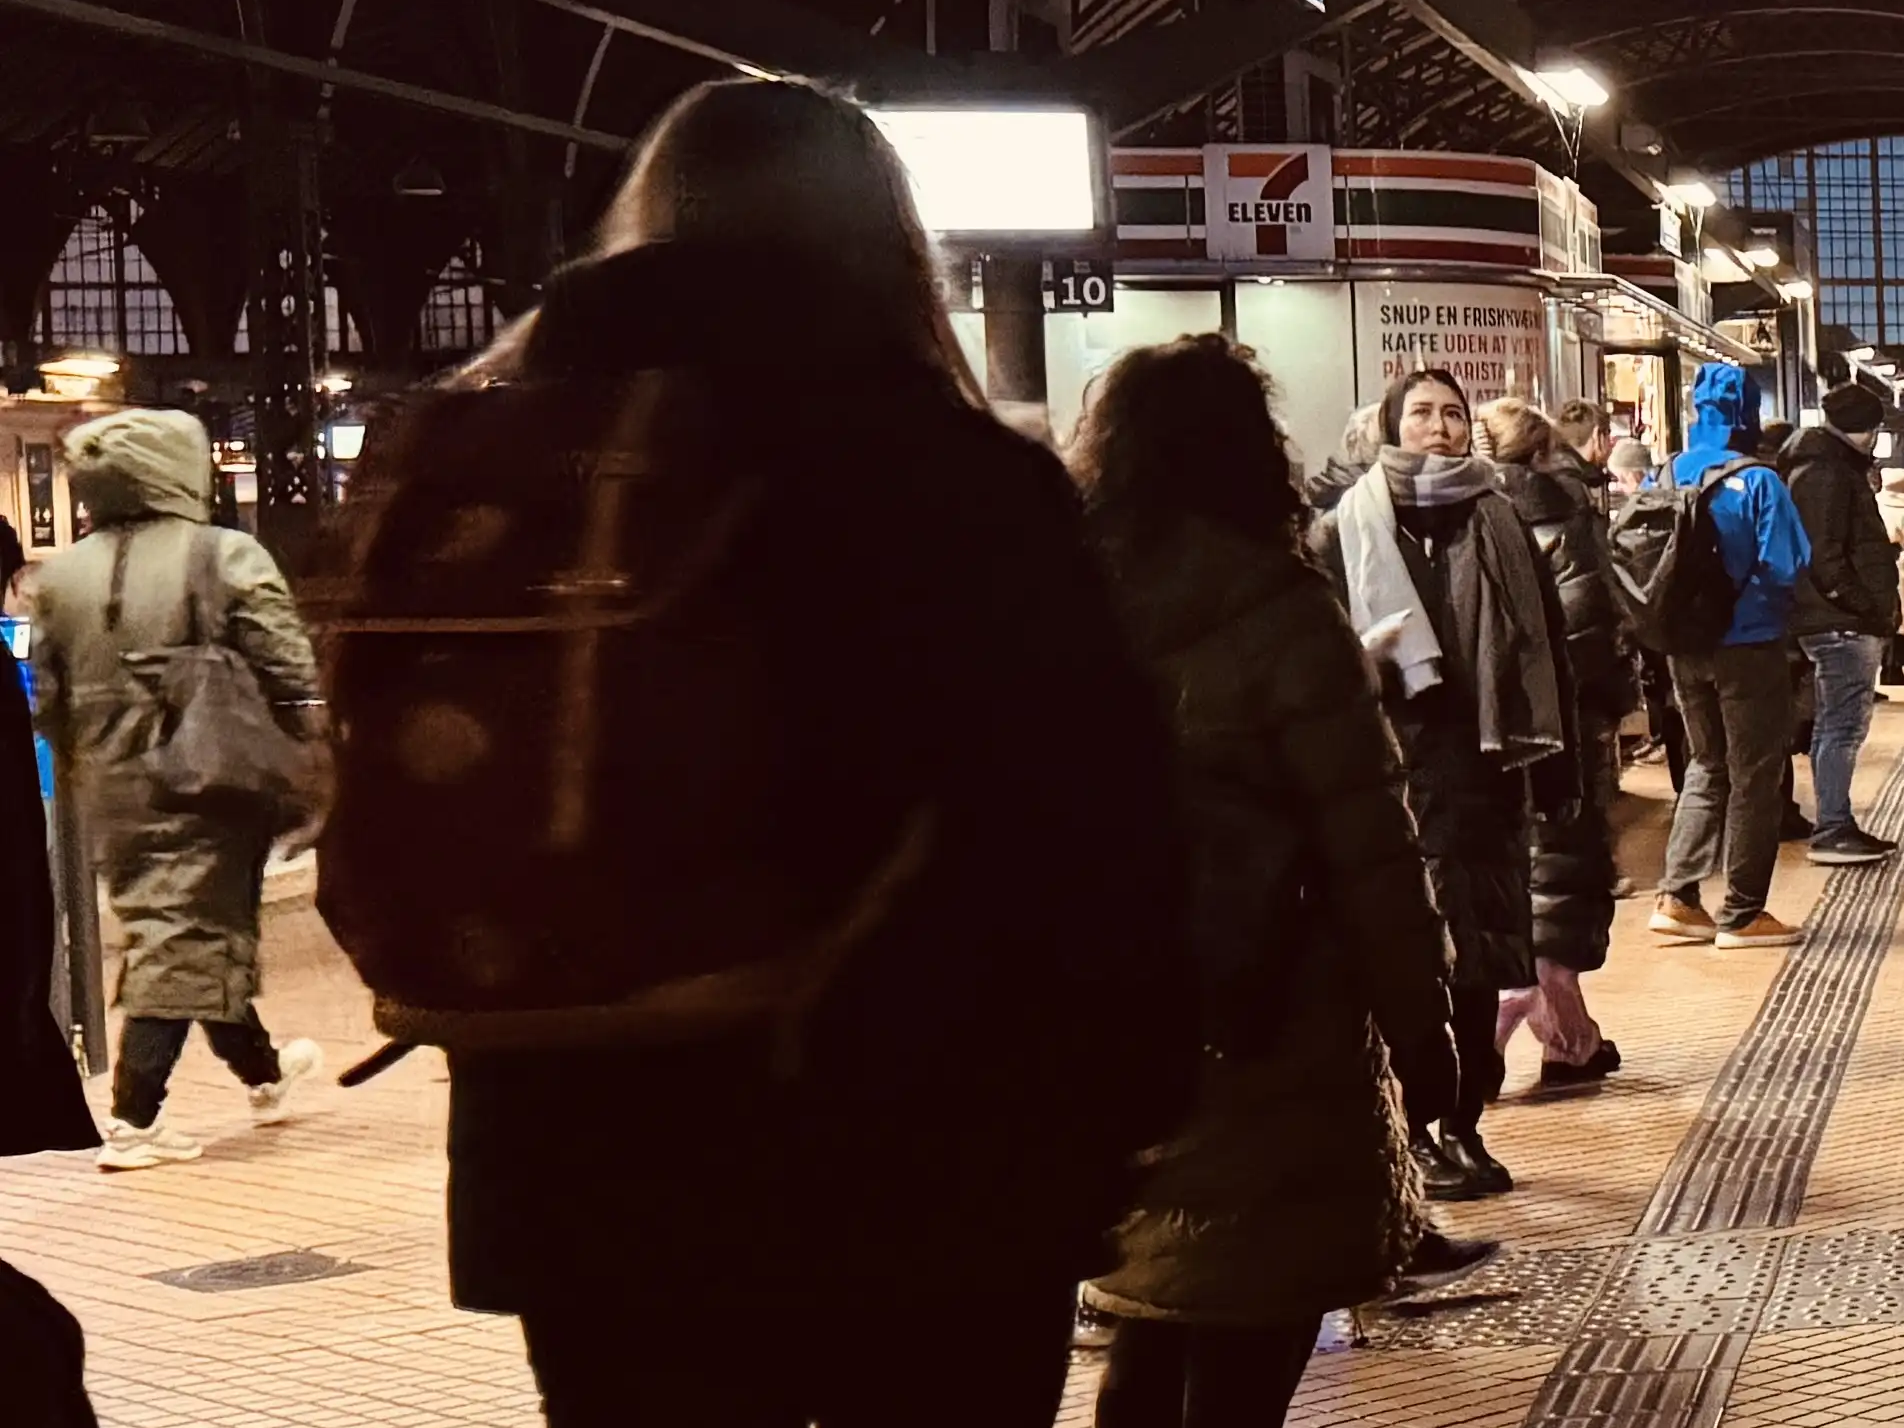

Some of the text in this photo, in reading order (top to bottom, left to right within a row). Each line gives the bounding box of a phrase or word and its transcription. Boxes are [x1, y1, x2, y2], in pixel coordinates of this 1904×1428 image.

[1061, 276, 1106, 305] 10
[1380, 304, 1430, 327] SNUP
[1436, 305, 1457, 326] EN
[1382, 332, 1438, 353] KAFFE
[1444, 333, 1488, 354] UDEN
[1492, 335, 1507, 355] AT
